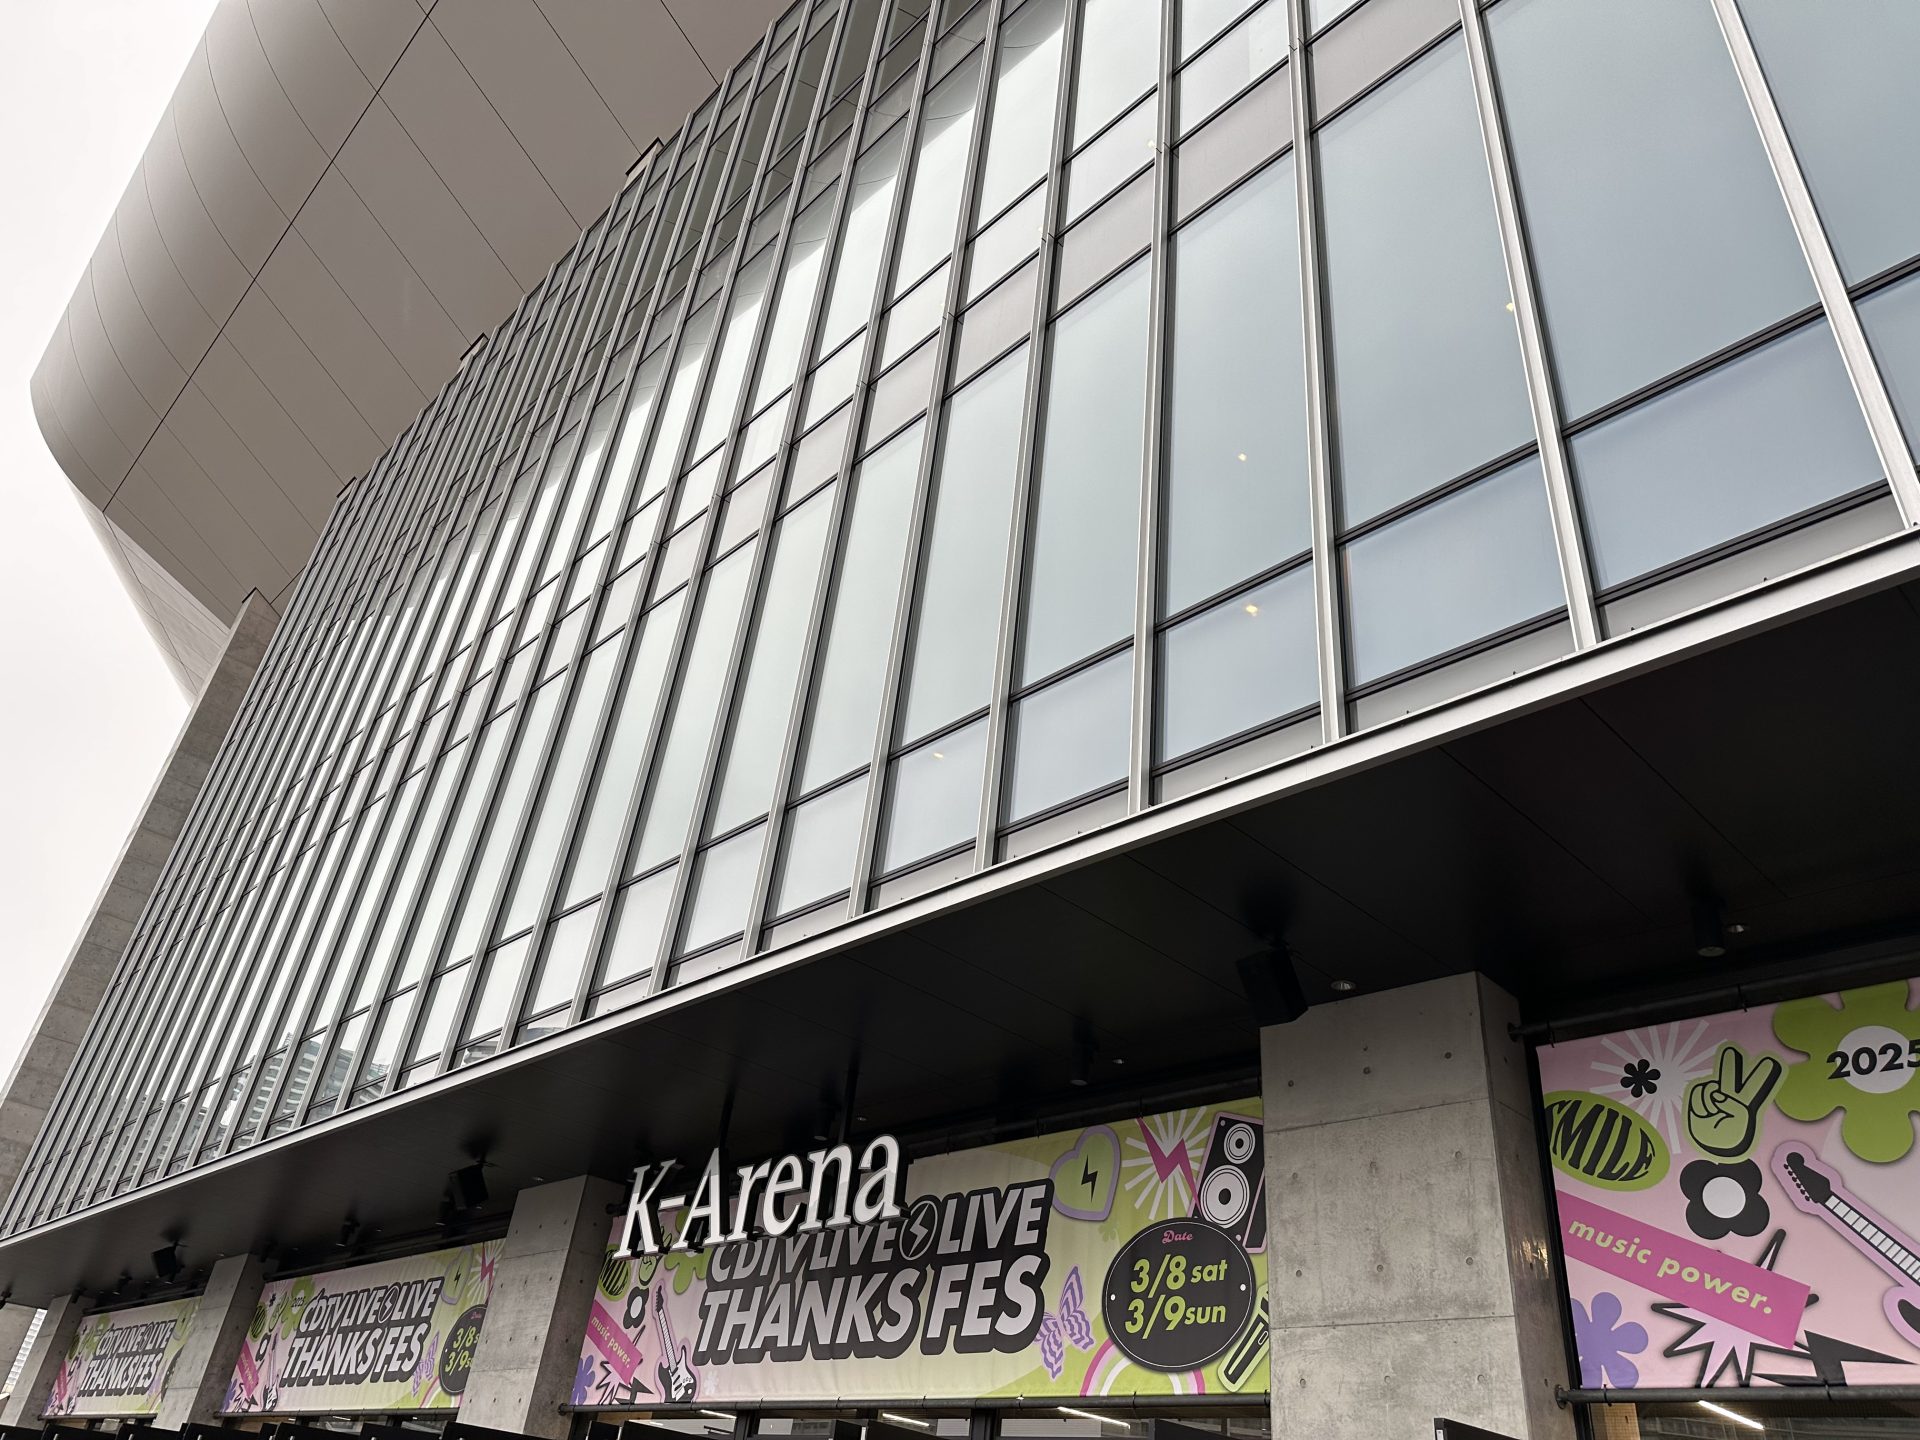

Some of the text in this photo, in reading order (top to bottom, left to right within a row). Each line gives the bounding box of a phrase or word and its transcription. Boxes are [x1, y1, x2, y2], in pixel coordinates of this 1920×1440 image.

[612, 1135, 900, 1260] K-Arena
[937, 1185, 1047, 1255] LIVE
[1162, 1230, 1194, 1243] Date
[1130, 1254, 1228, 1298] 3/8 sat
[1568, 1220, 1773, 1314] music power.
[445, 1350, 469, 1376] 3/9
[453, 1326, 476, 1352] 3/8
[591, 1316, 631, 1368] music power.
